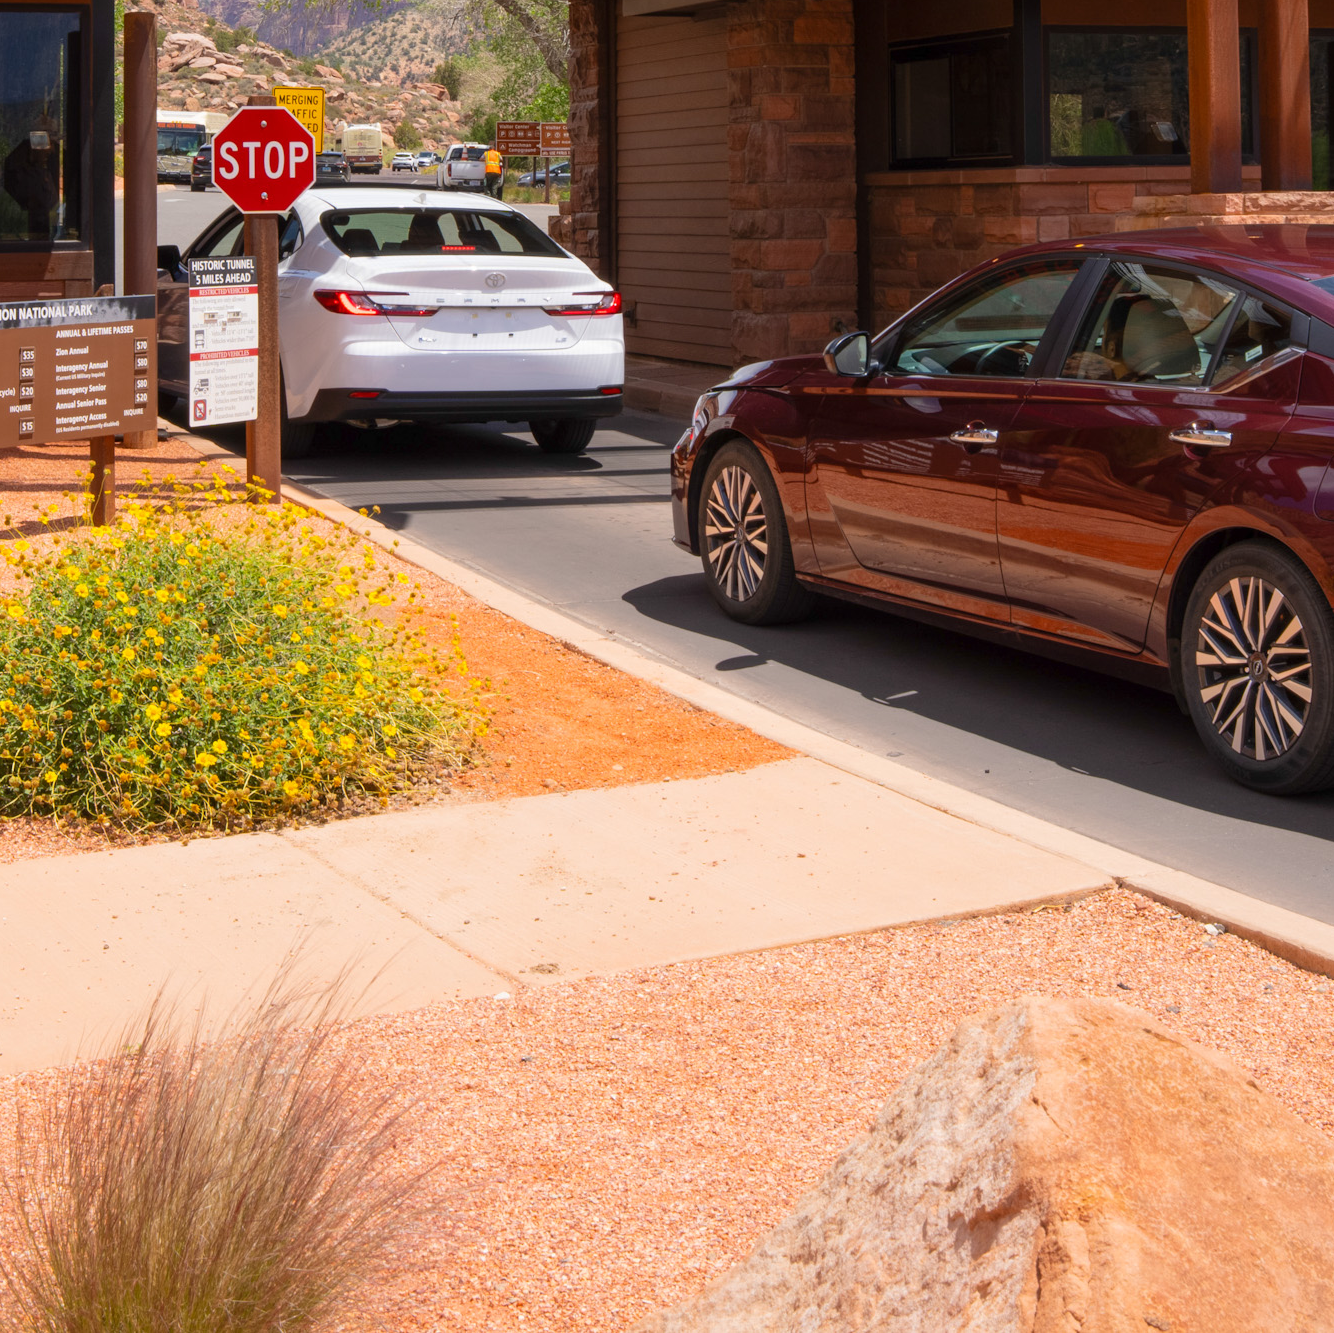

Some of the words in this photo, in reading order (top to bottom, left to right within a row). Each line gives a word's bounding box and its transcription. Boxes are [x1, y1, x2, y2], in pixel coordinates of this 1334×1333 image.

[278, 95, 319, 105] MERGING
[291, 109, 317, 119] AFFIC
[219, 141, 309, 180] STOP
[191, 260, 225, 271] HISTORIC
[226, 259, 255, 270] TUNNEL
[196, 275, 201, 285] 5
[202, 274, 224, 285] MILES
[225, 272, 251, 283] AHEAD
[199, 288, 227, 296] RESTRICTED
[19, 306, 67, 320] NATIONAL
[68, 304, 93, 317] PARK
[55, 329, 81, 339] ANNUAL
[87, 326, 112, 336] LIFETIME
[112, 325, 134, 334] PASSES
[136, 340, 147, 350] $70
[22, 350, 35, 360] $35
[55, 347, 68, 356] Zion
[69, 346, 89, 356] Annual
[200, 352, 227, 360] PROHIBITED
[55, 363, 88, 373] Interagency
[88, 360, 109, 369] Annual
[137, 357, 148, 367] $80
[21, 367, 34, 377] $30
[136, 379, 147, 389] $80
[21, 386, 34, 396] $20
[55, 386, 88, 396] Interagency
[89, 383, 106, 393] Senior
[136, 393, 147, 402] $20
[9, 404, 32, 414] INQUIRE
[55, 400, 76, 410] Annual
[76, 398, 94, 408] Senior
[94, 398, 107, 406] Pass
[123, 408, 144, 417] INQUIRE
[55, 415, 88, 425] Interagency
[89, 413, 107, 421] Access
[22, 421, 33, 431] $15
